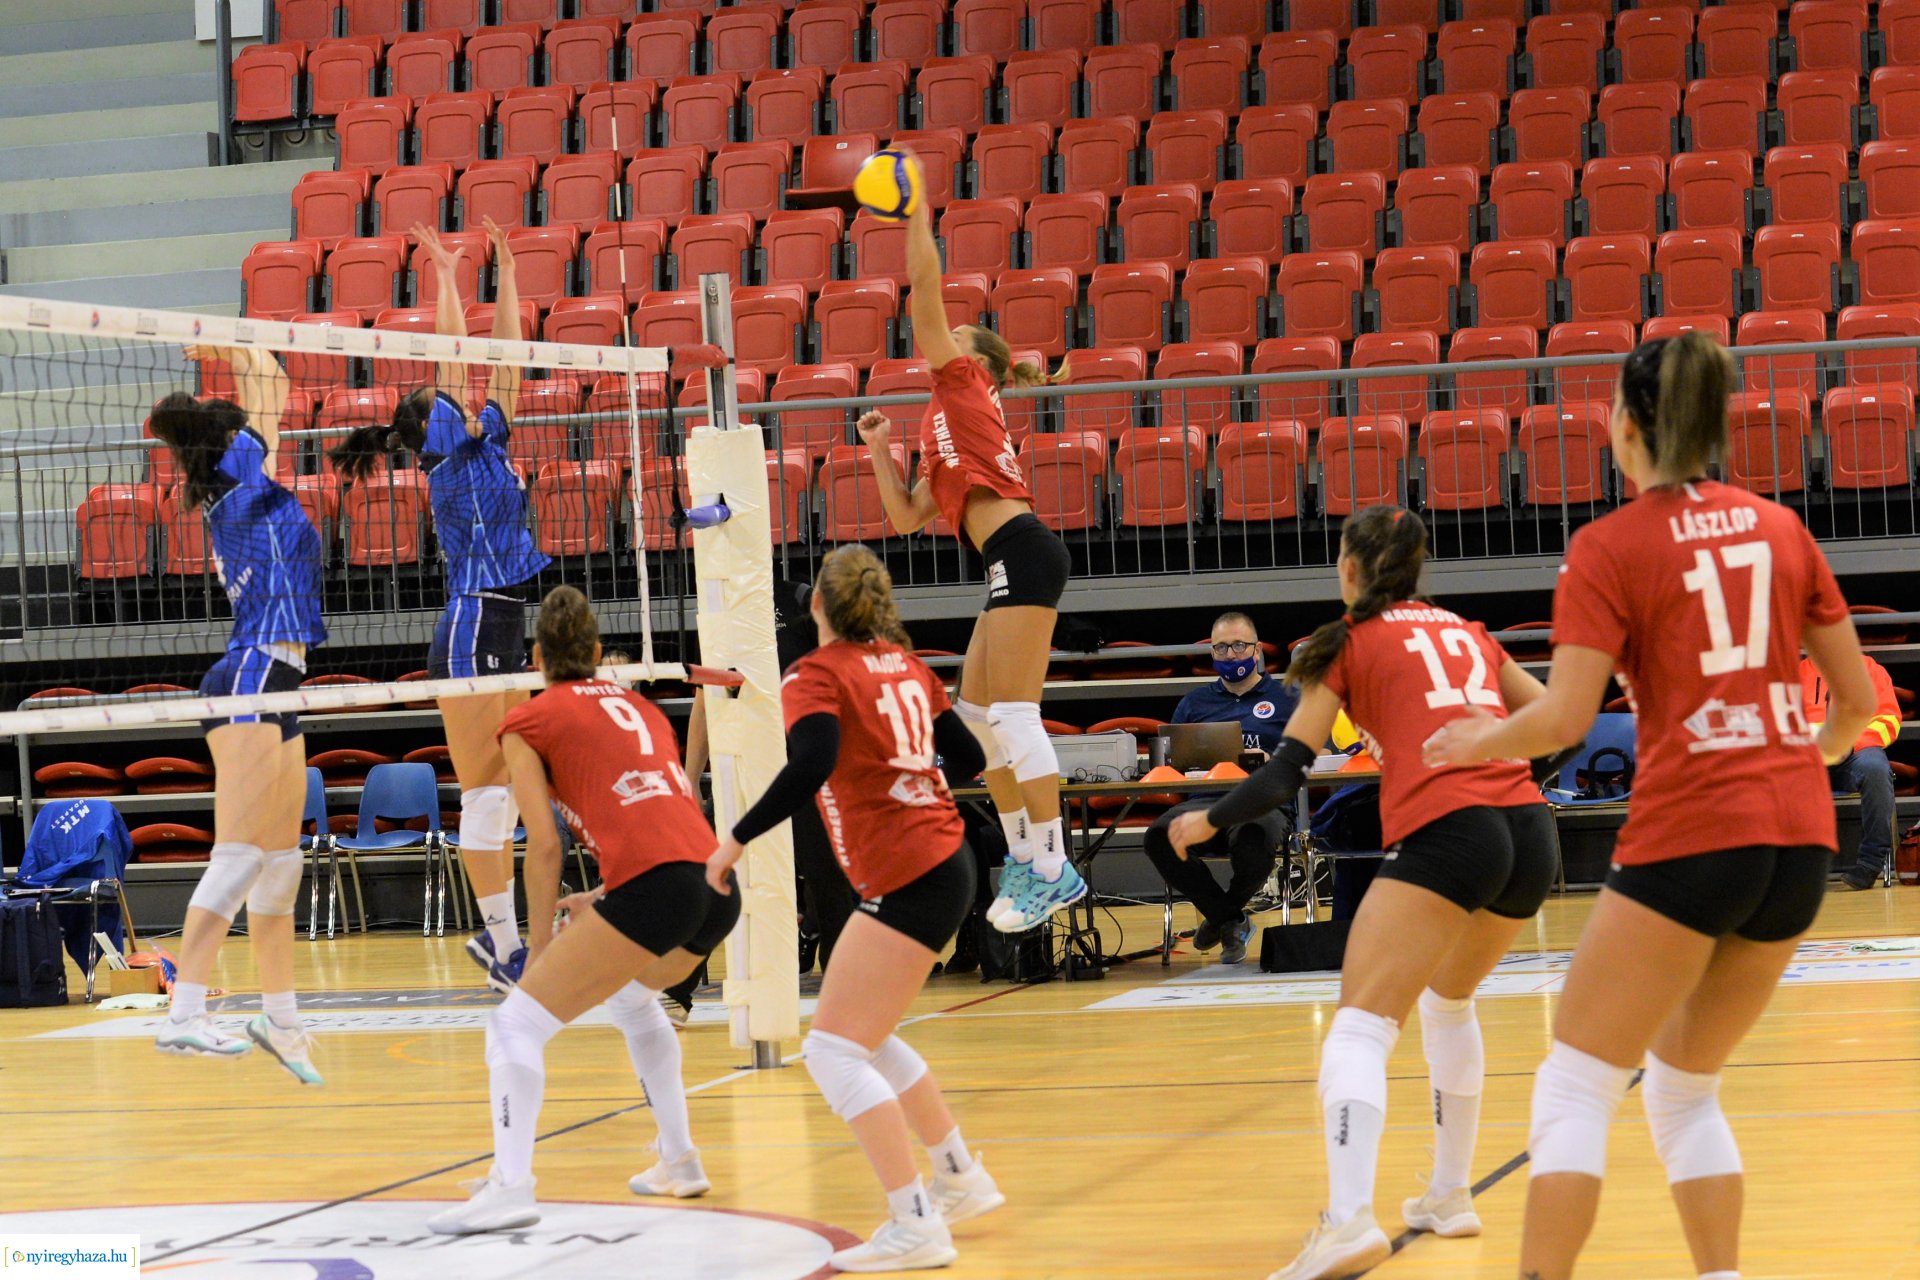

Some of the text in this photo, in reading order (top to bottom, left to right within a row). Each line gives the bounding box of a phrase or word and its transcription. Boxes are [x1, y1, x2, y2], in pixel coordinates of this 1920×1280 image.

[1669, 506, 1758, 544] LÁSZLOP
[992, 589, 1009, 598] JAKO
[1682, 541, 1773, 677] 17
[1403, 627, 1501, 709] 12
[572, 684, 626, 696] PINTÉR
[599, 696, 654, 755] 9
[875, 679, 934, 771] 10
[51, 800, 84, 829] UDAPEST
[60, 805, 90, 834] MTK
